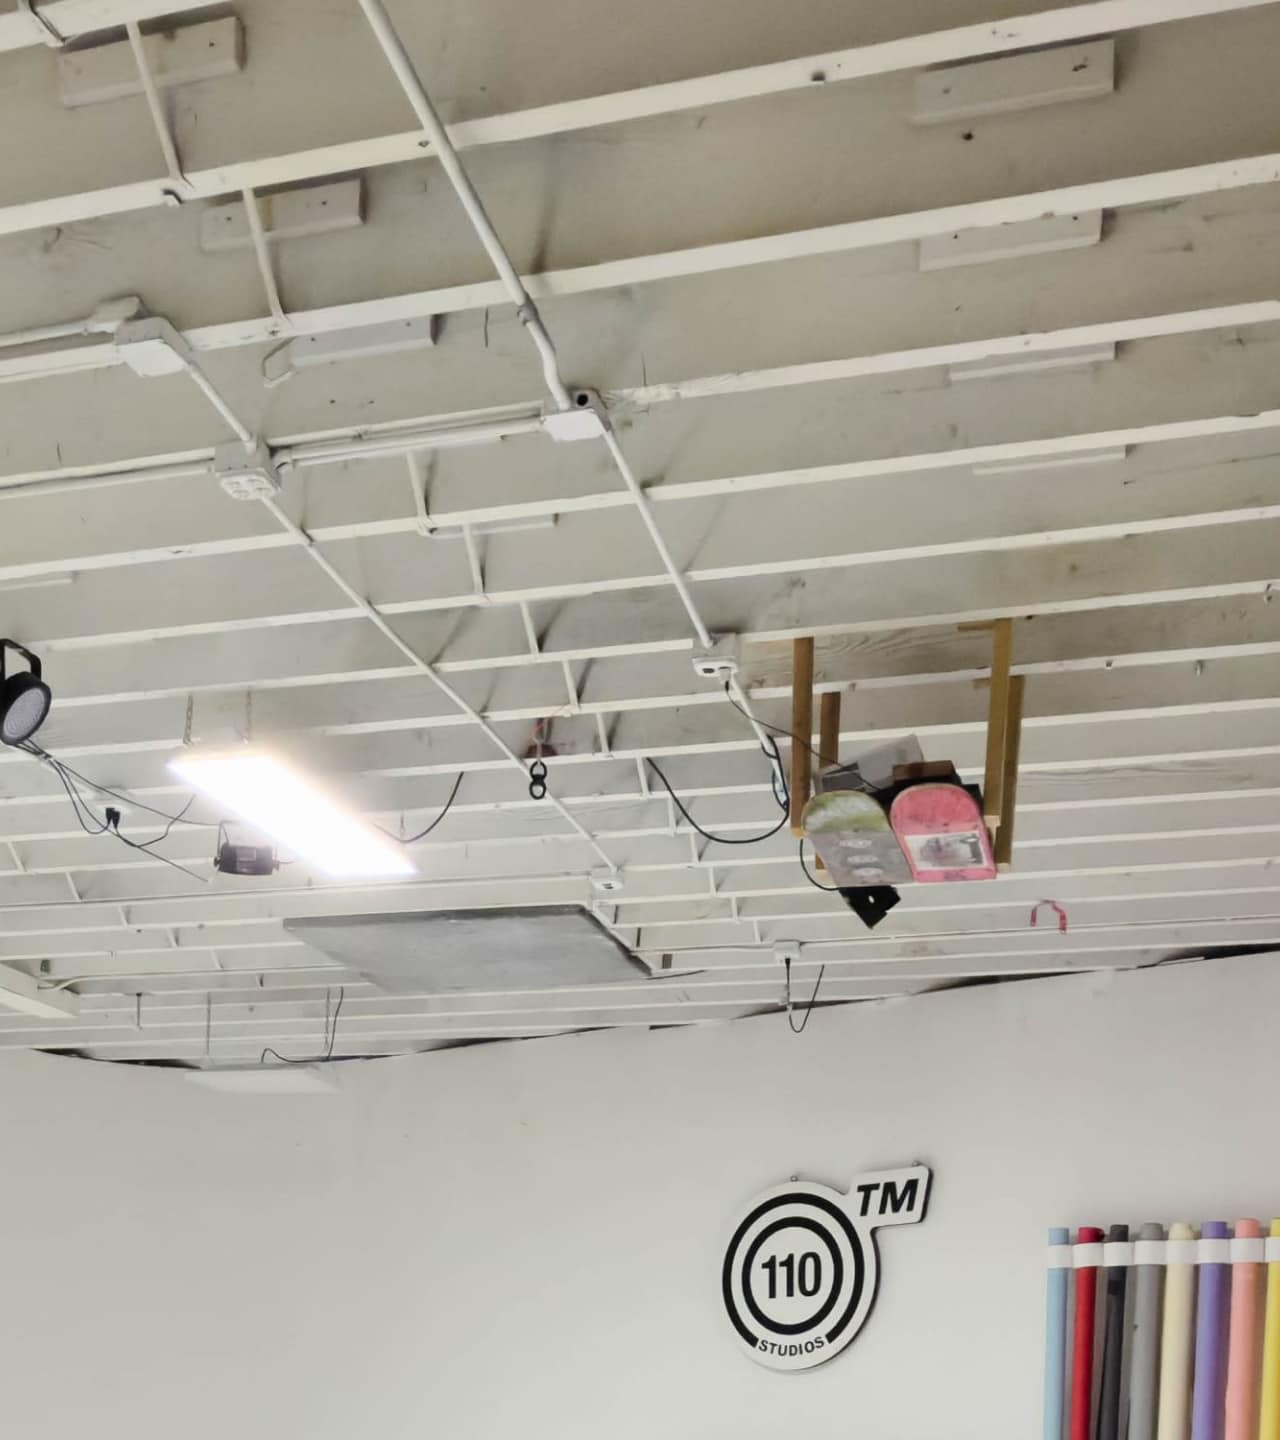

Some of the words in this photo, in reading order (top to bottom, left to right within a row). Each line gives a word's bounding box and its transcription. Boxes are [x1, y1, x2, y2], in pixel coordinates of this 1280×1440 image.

[857, 1178, 919, 1217] TM
[761, 1251, 822, 1299] 110
[758, 1336, 825, 1356] STUDIOS
